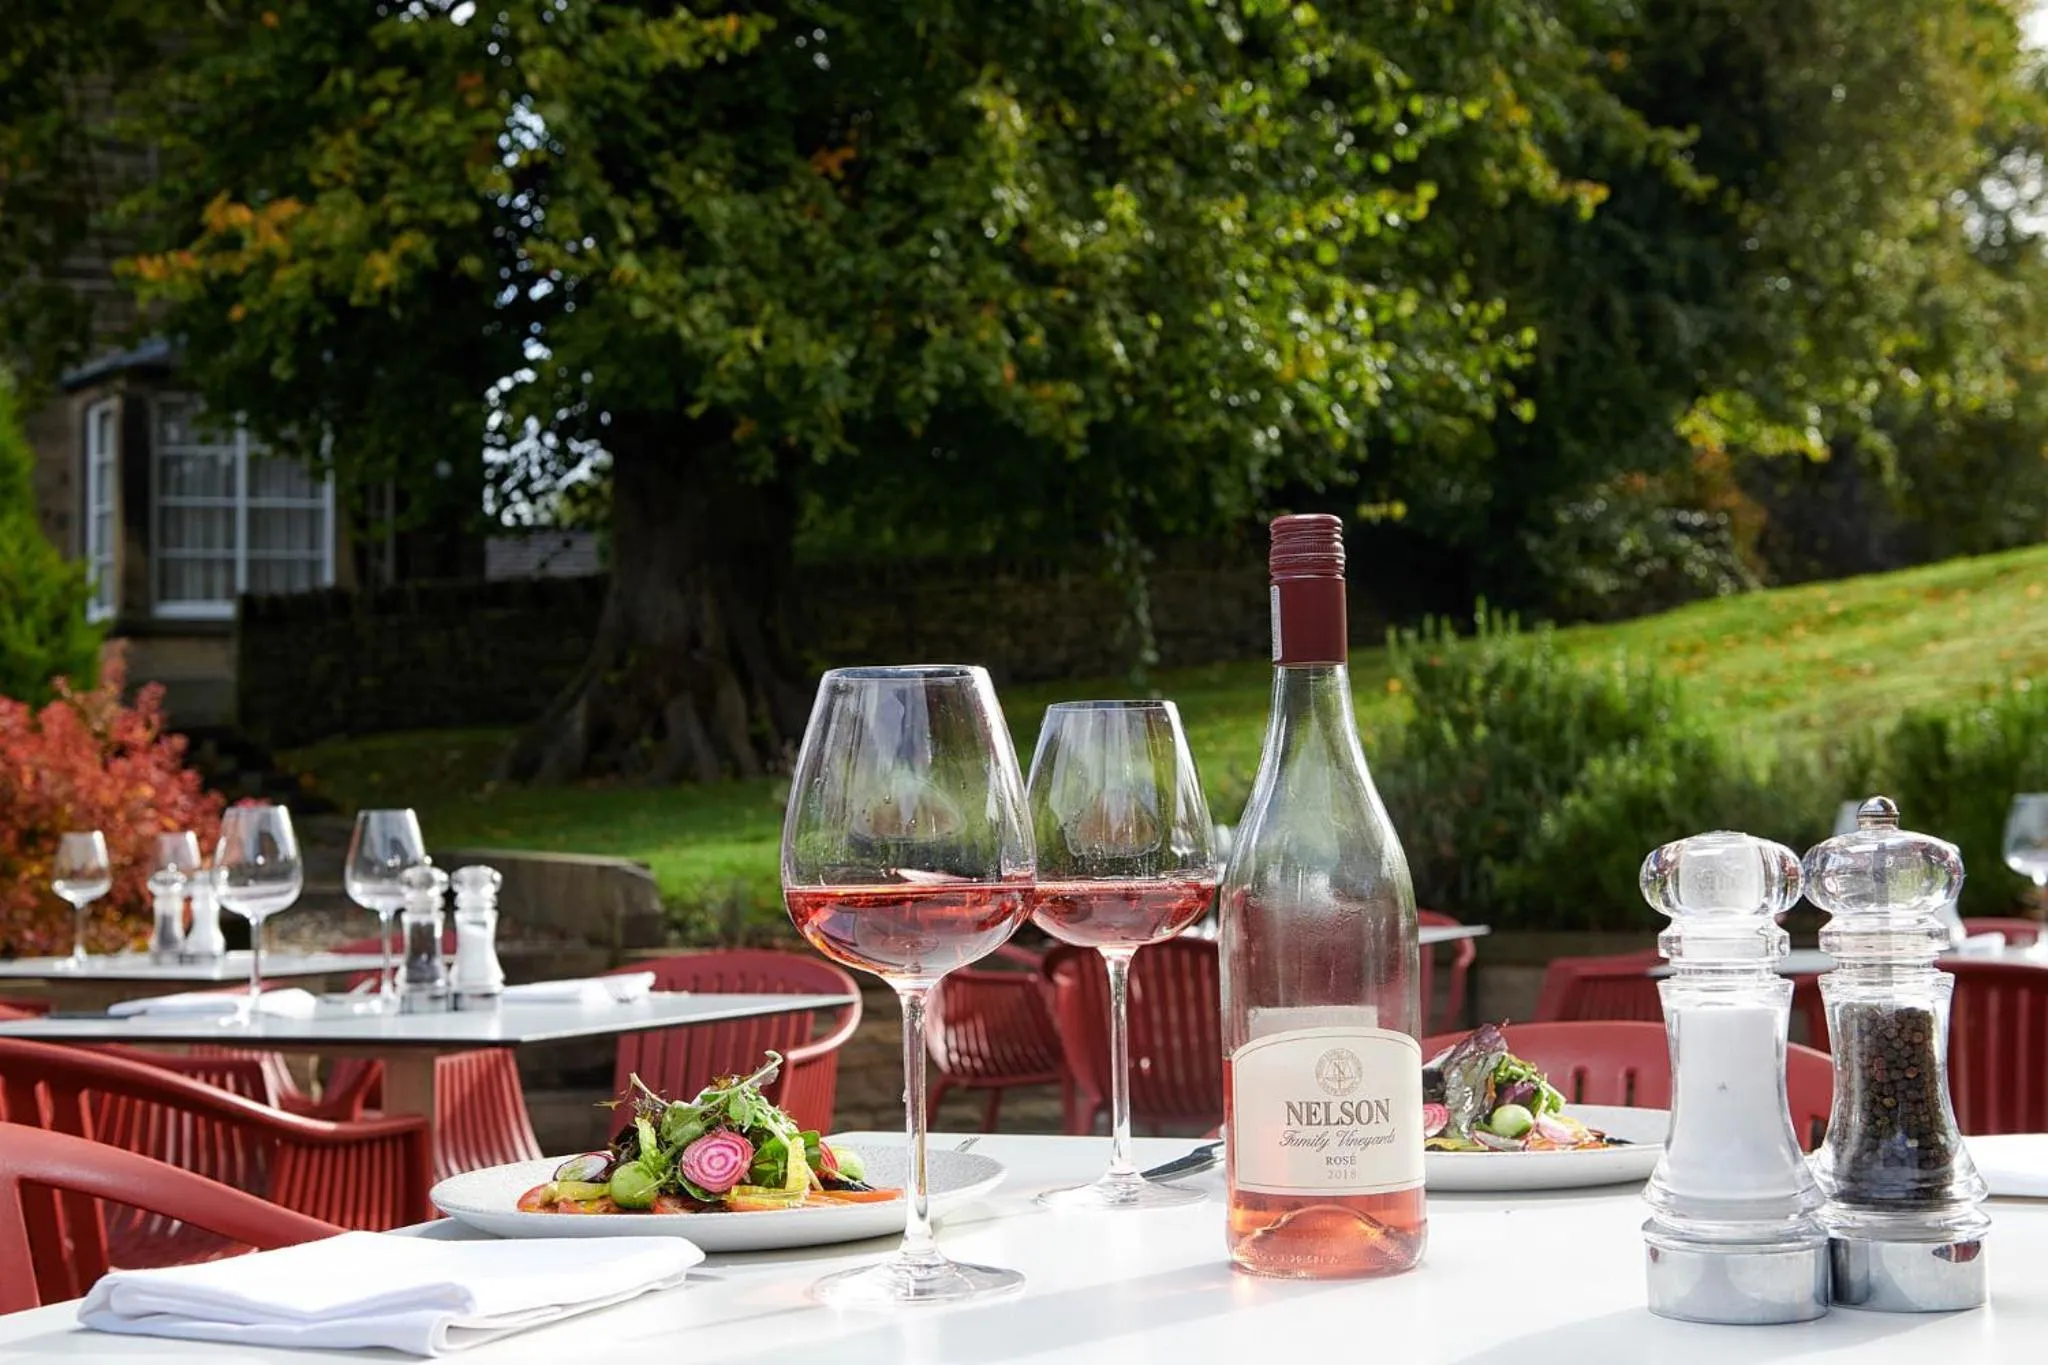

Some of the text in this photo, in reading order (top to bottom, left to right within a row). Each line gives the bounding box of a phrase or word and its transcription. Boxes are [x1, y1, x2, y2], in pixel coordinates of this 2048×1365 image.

[1332, 1061, 1346, 1076] N
[1285, 1099, 1391, 1126] NELSON
[1279, 1128, 1396, 1152] Family Vineyards
[1325, 1153, 1357, 1166] ROSÉ
